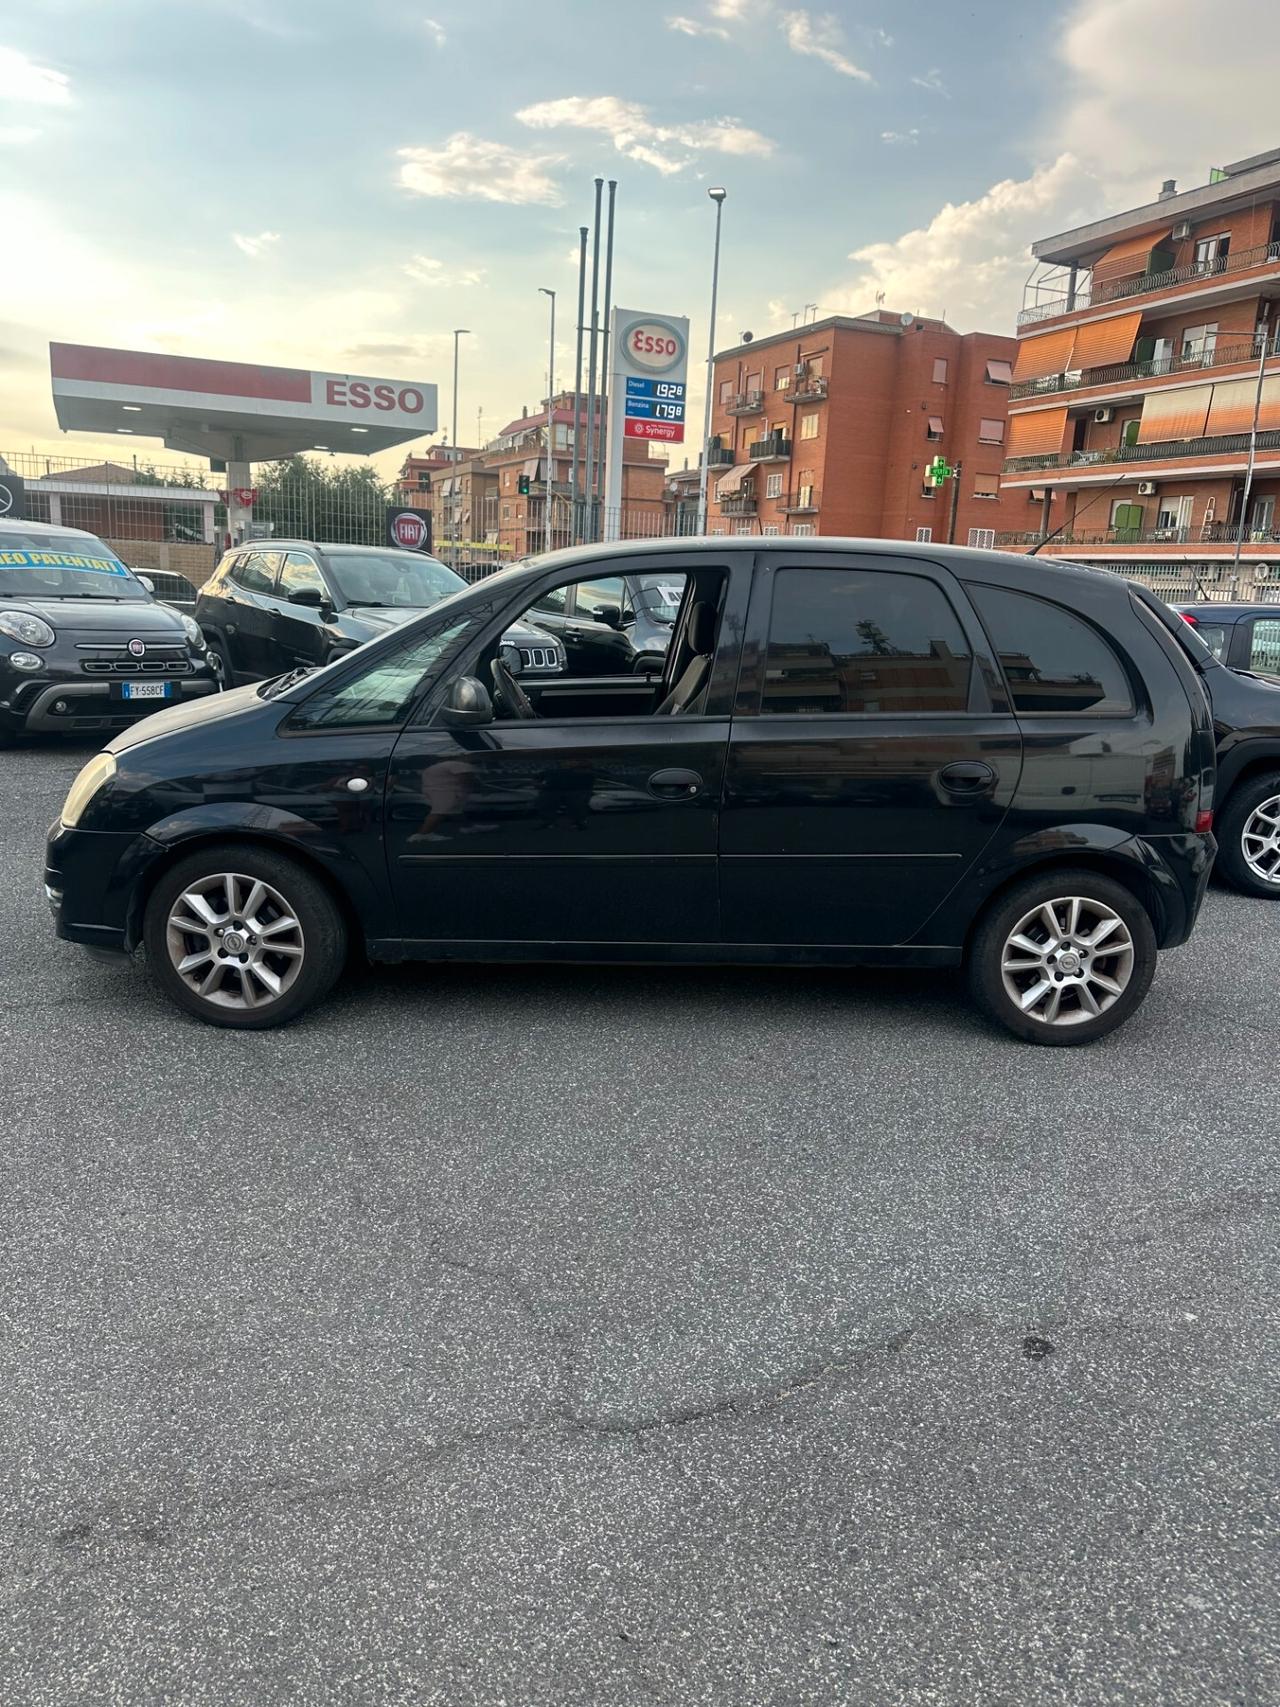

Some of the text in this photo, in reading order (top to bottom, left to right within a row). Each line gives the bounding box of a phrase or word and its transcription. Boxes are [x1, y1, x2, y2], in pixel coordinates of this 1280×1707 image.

[628, 380, 645, 388] Diesel
[326, 380, 424, 414] ESSO
[627, 400, 649, 409] Benzina
[645, 425, 676, 438] Synergy
[400, 524, 420, 540] FIAT
